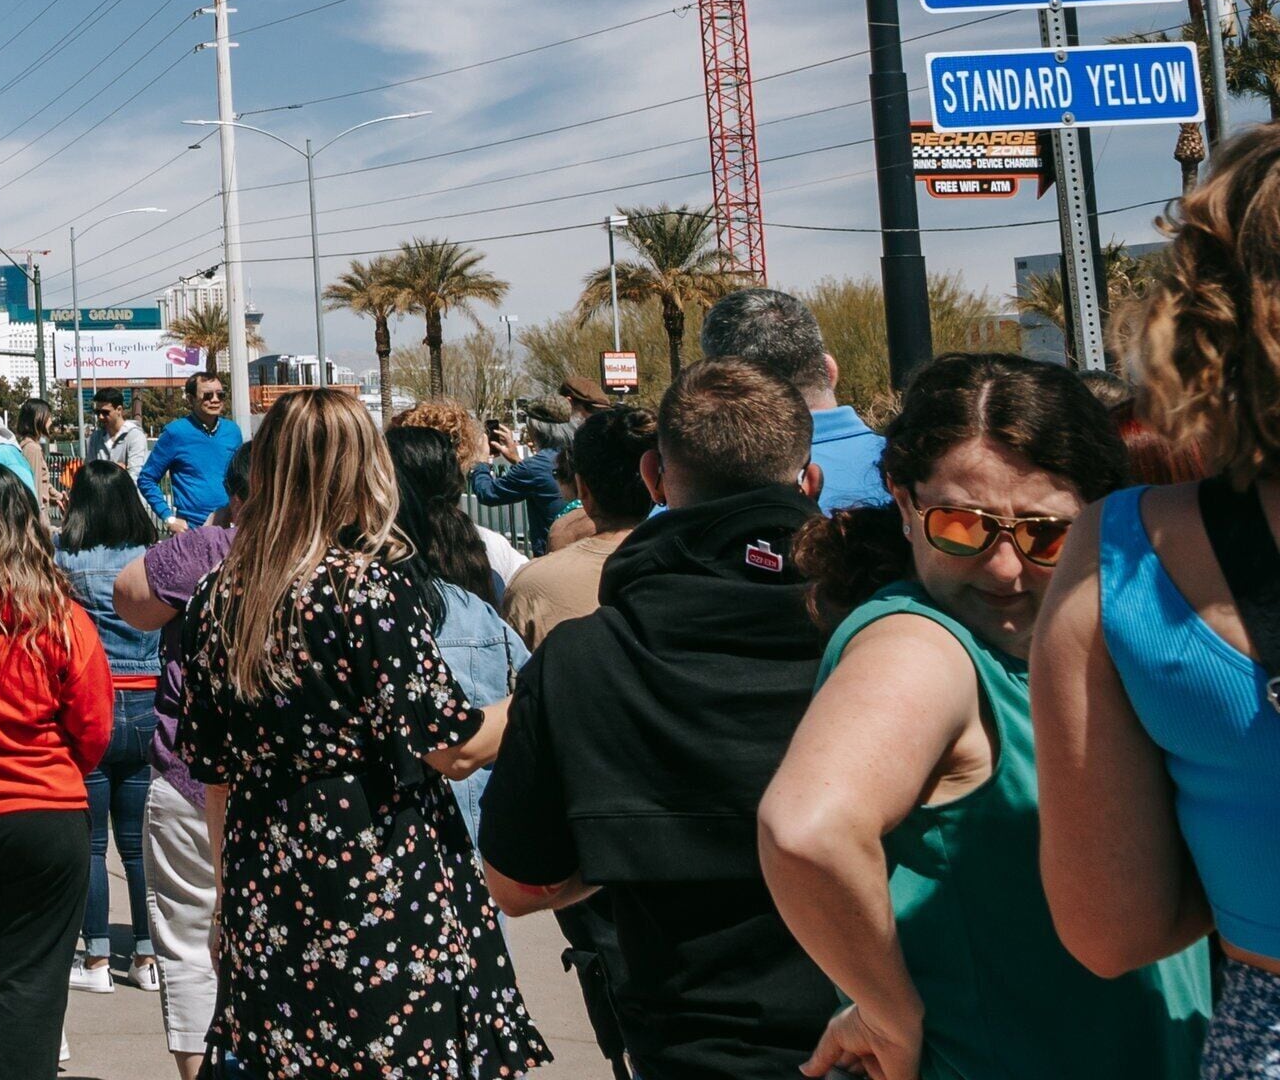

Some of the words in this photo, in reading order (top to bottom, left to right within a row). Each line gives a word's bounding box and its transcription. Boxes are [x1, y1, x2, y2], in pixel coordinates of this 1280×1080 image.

[941, 66, 1073, 114] STANDARD
[1085, 60, 1187, 107] YELLOW
[910, 131, 1037, 146] RECHARGE
[989, 145, 1037, 156] ZONE
[913, 159, 938, 170] RINKS
[941, 159, 972, 169] SNACKS
[976, 158, 1003, 169] DEVICE
[934, 181, 959, 193] FREE
[959, 181, 981, 193] WIFI
[990, 181, 1012, 192] ATM
[50, 310, 82, 321] MGM
[89, 309, 134, 321] GRAND
[72, 356, 131, 369] PnkCherry
